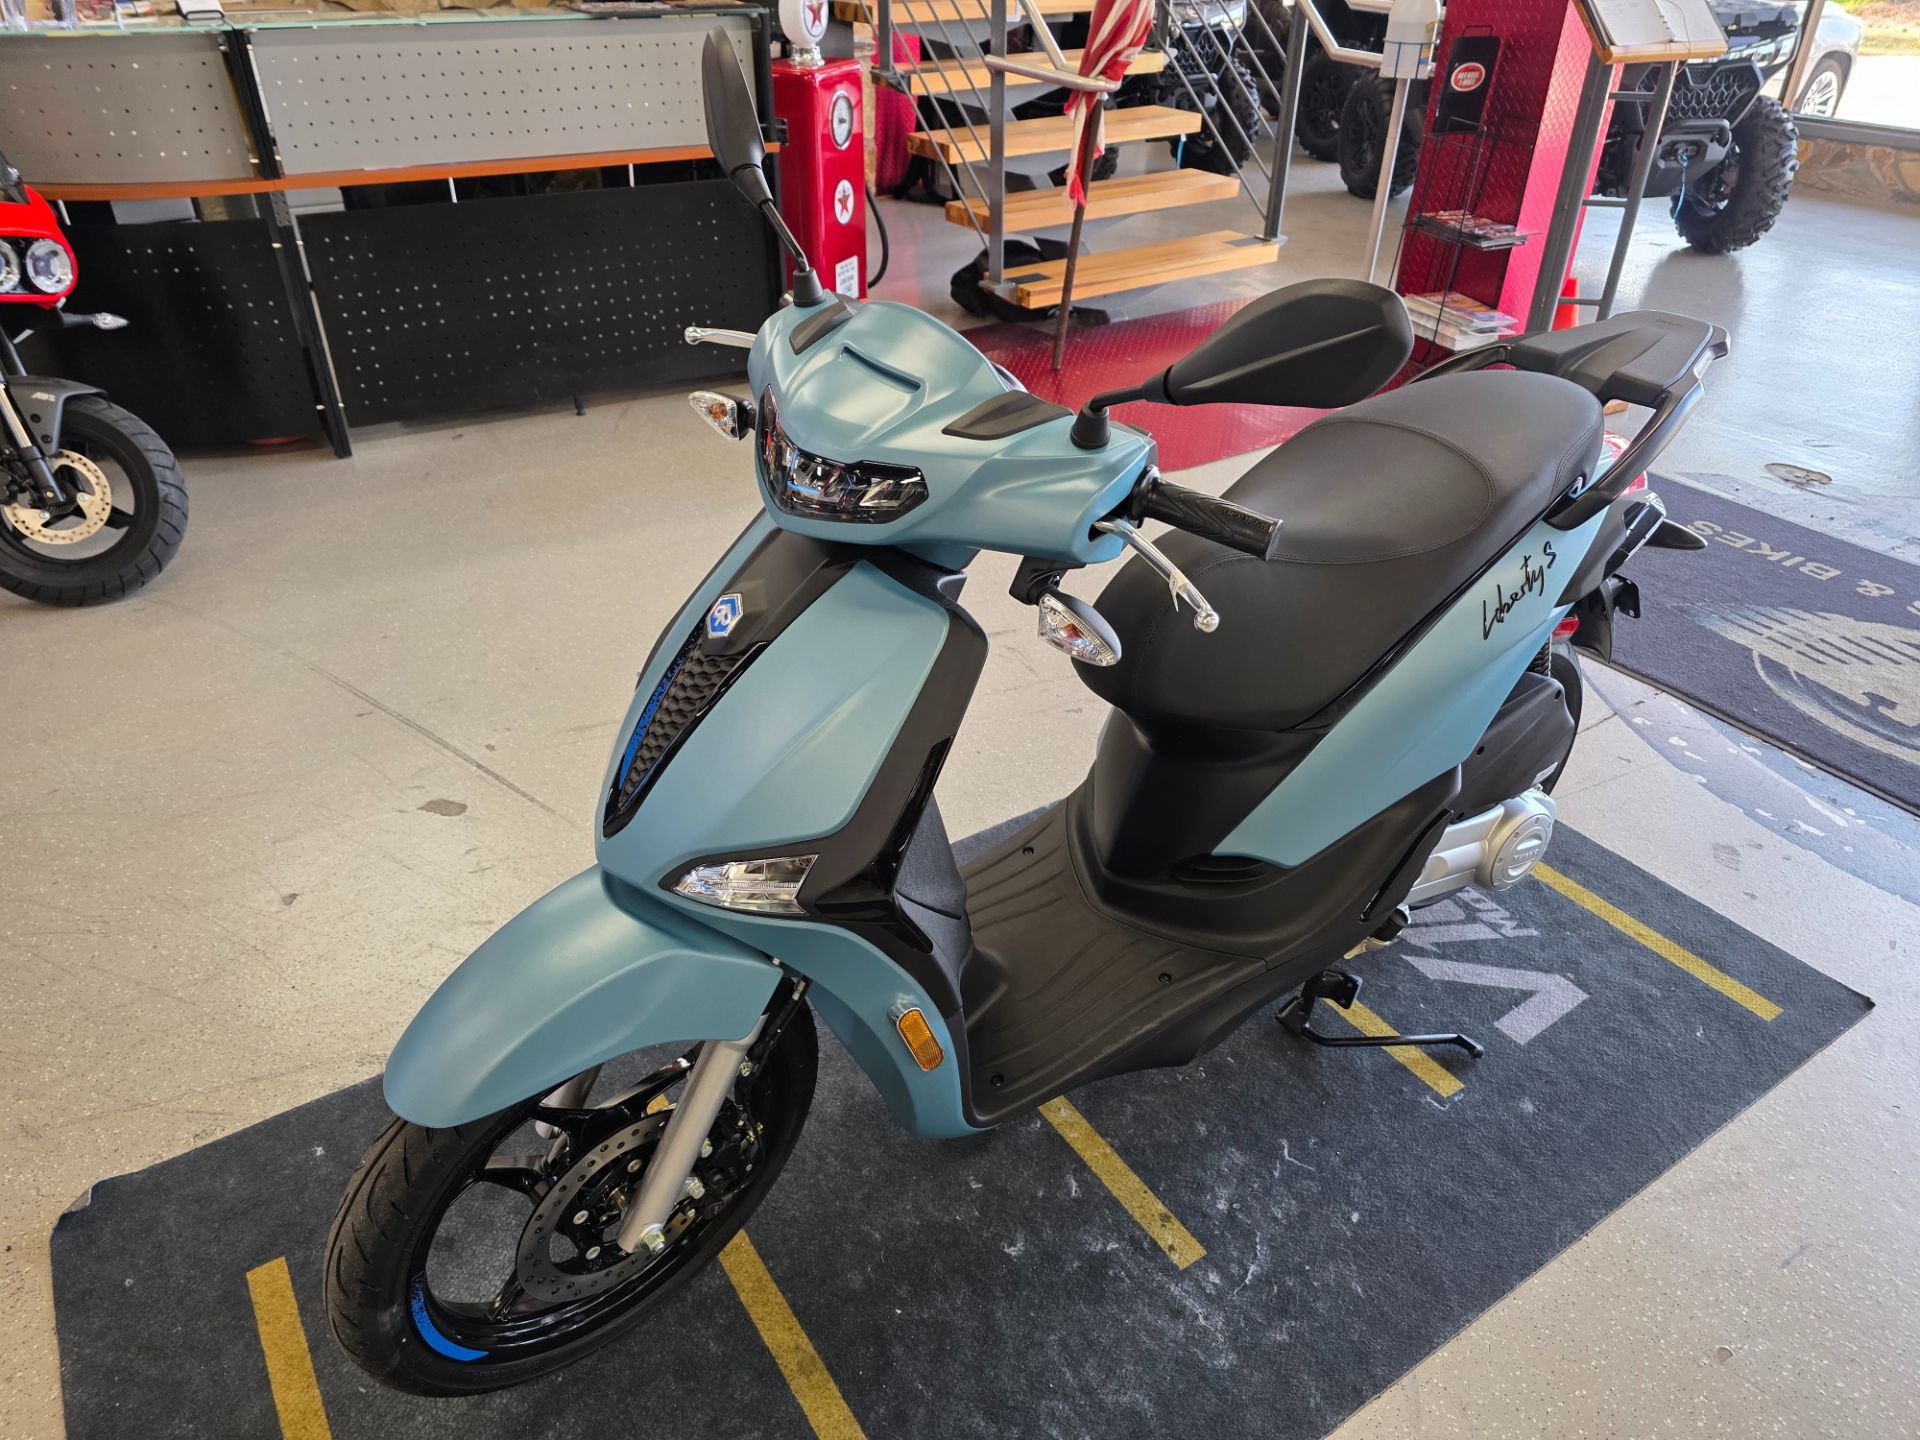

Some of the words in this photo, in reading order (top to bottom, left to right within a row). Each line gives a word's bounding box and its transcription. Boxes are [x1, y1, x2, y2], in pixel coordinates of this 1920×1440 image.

[1687, 520, 1842, 581] BIKES
[1483, 554, 1545, 641] Liberty
[1856, 578, 1895, 598] &
